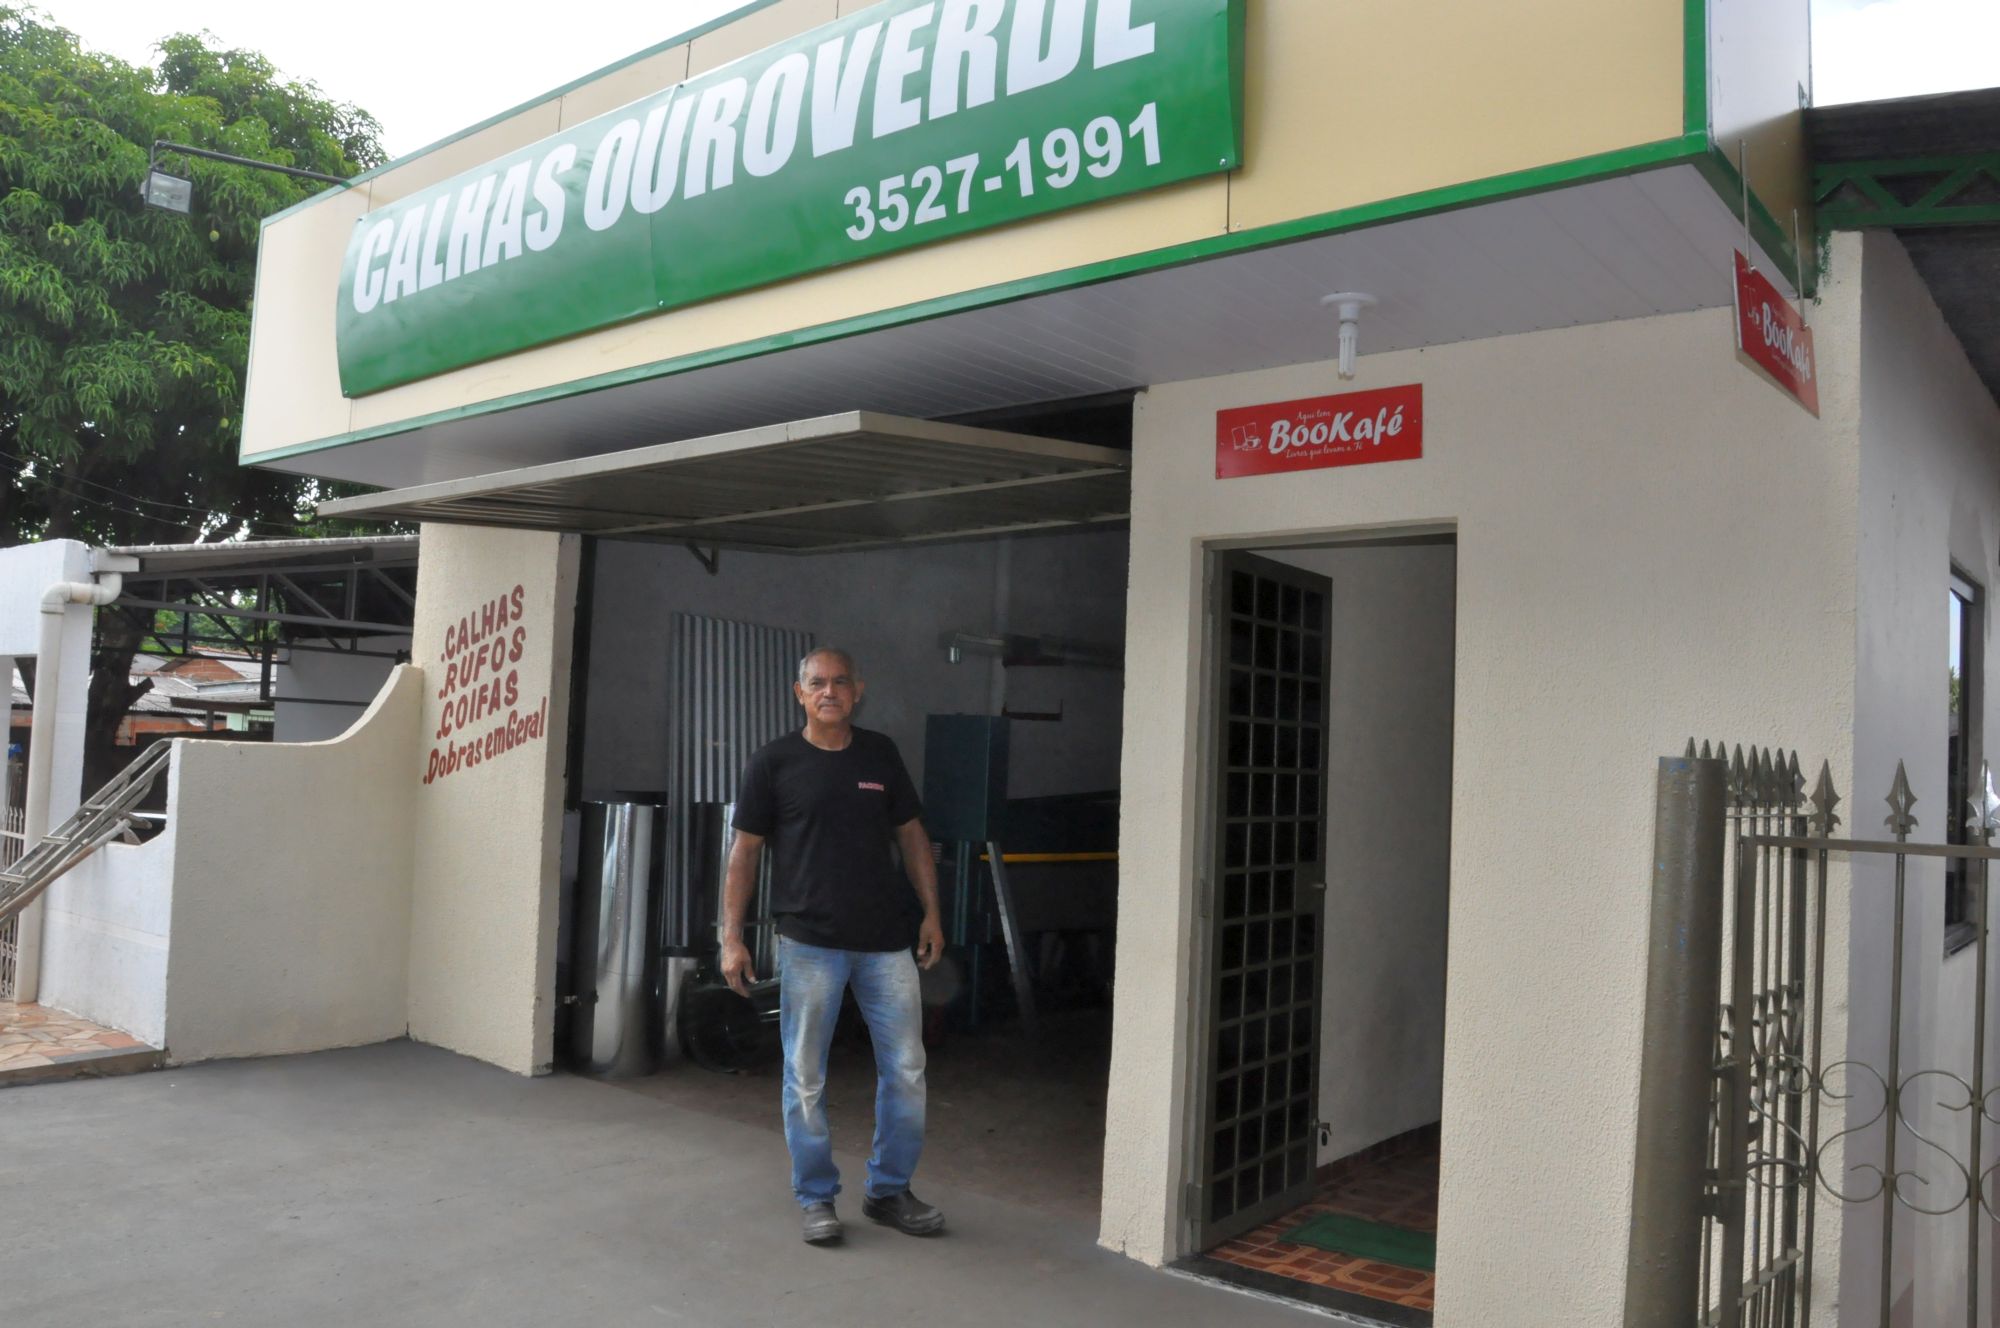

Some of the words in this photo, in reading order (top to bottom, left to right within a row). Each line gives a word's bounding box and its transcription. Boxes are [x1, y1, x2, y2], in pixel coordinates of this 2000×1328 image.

[352, 143, 576, 314] CALHAS
[843, 102, 1161, 241] 3527-1991
[1268, 405, 1404, 454] BooKafé
